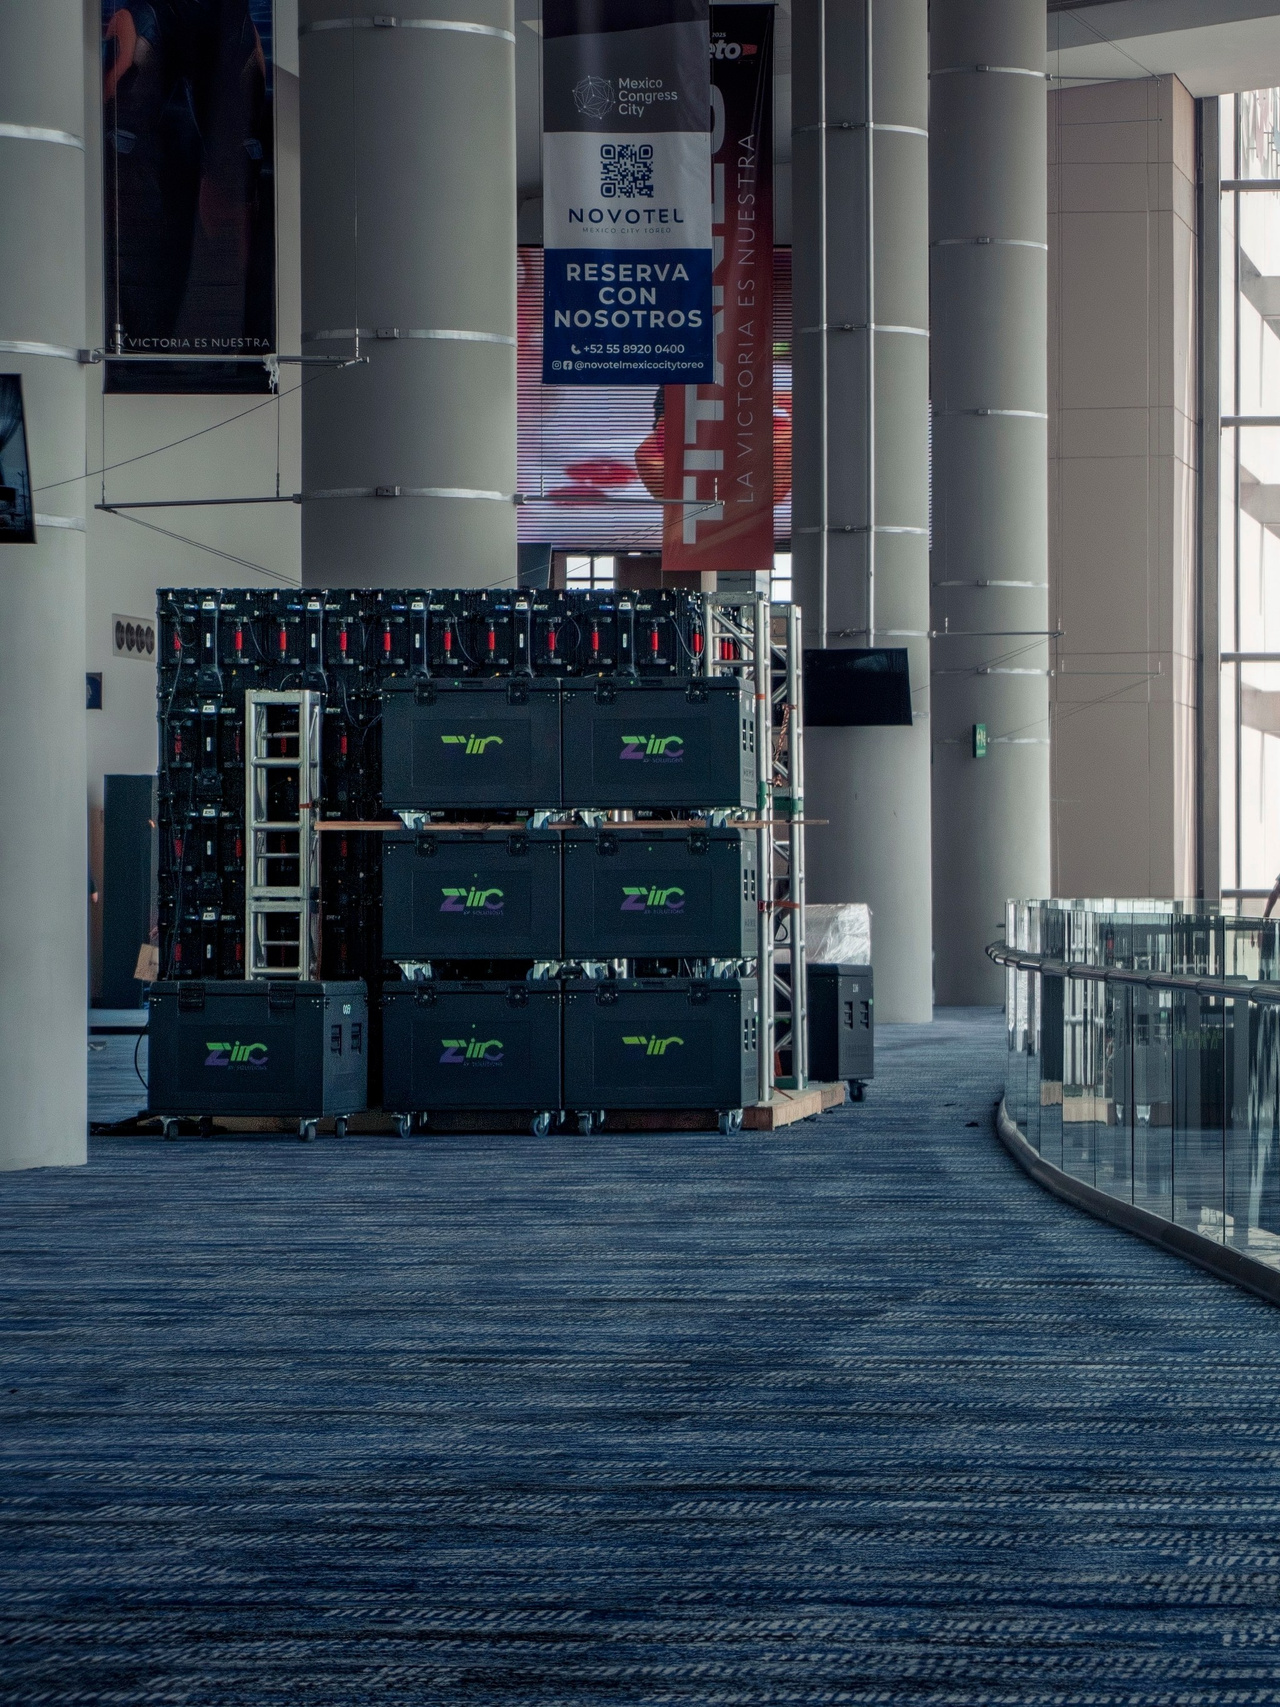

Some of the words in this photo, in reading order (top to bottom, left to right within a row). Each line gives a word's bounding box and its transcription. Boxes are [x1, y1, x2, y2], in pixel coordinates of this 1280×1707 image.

[618, 77, 663, 89] Mexico
[618, 90, 678, 104] Congress
[618, 103, 645, 118] City
[737, 134, 756, 266] NUESTRA
[568, 208, 684, 225] NOVOTEL
[582, 226, 617, 235] MEXICO
[620, 227, 640, 235] CITY
[644, 227, 672, 235] TOREO
[566, 263, 690, 282] RESERVA
[598, 286, 656, 305] CON
[737, 279, 755, 307] ES
[554, 309, 703, 329] NOSOTROS
[129, 337, 191, 348] VICTORIA
[194, 338, 208, 348] ES
[211, 337, 270, 348] NUESTRA
[583, 344, 604, 354] +52
[606, 344, 621, 354] 55
[622, 344, 652, 354] 8920
[654, 344, 685, 354] 0400
[574, 360, 704, 371] @novotelmexicocitytoreo
[737, 321, 754, 458] VICTORIA
[737, 471, 754, 503] LA
